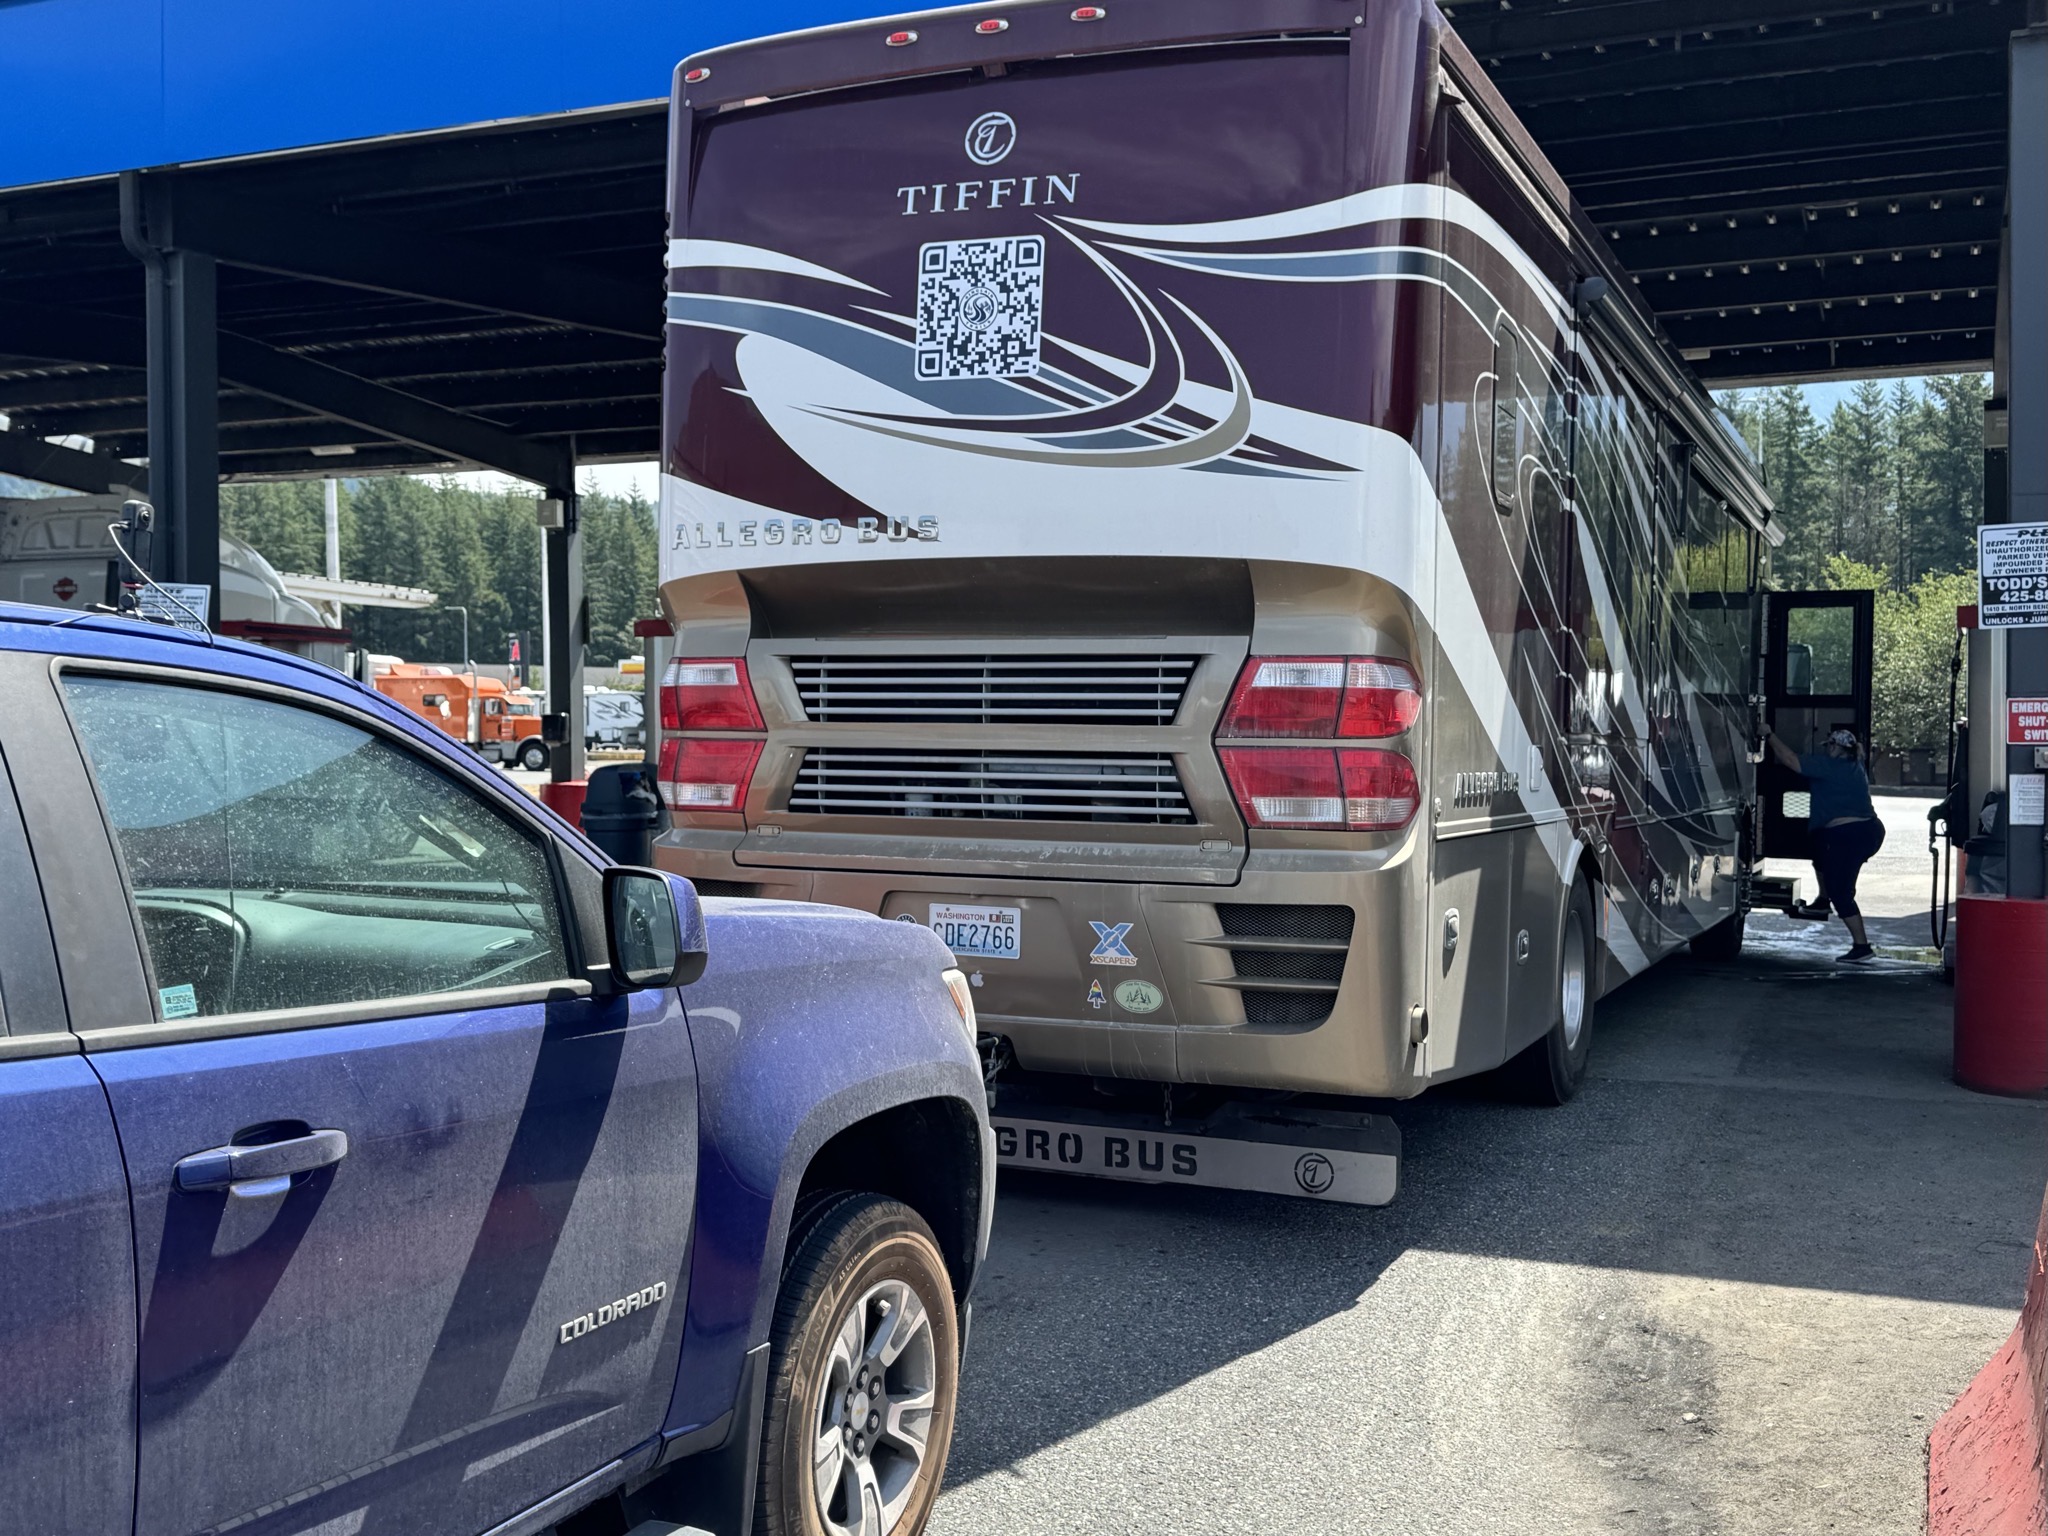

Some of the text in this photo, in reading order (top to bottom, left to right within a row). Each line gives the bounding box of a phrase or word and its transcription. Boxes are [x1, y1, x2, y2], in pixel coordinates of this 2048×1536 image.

[897, 172, 1081, 216] TIFFIN
[671, 514, 940, 550] ALLEGRO BUS
[1985, 539, 2018, 548] RESPECT
[1997, 553, 2030, 561] PARKED
[1993, 559, 2043, 568] IMPOUNDED
[2005, 566, 2043, 575] OWNER'S
[1986, 576, 2048, 591] TODD'S
[1985, 616, 2024, 625] UNLOCKS
[936, 911, 985, 922] WASHINGTON
[1091, 954, 1137, 966] XSCAPERS
[1104, 1136, 1198, 1177] BUS
[560, 1281, 667, 1344] COLORADO
